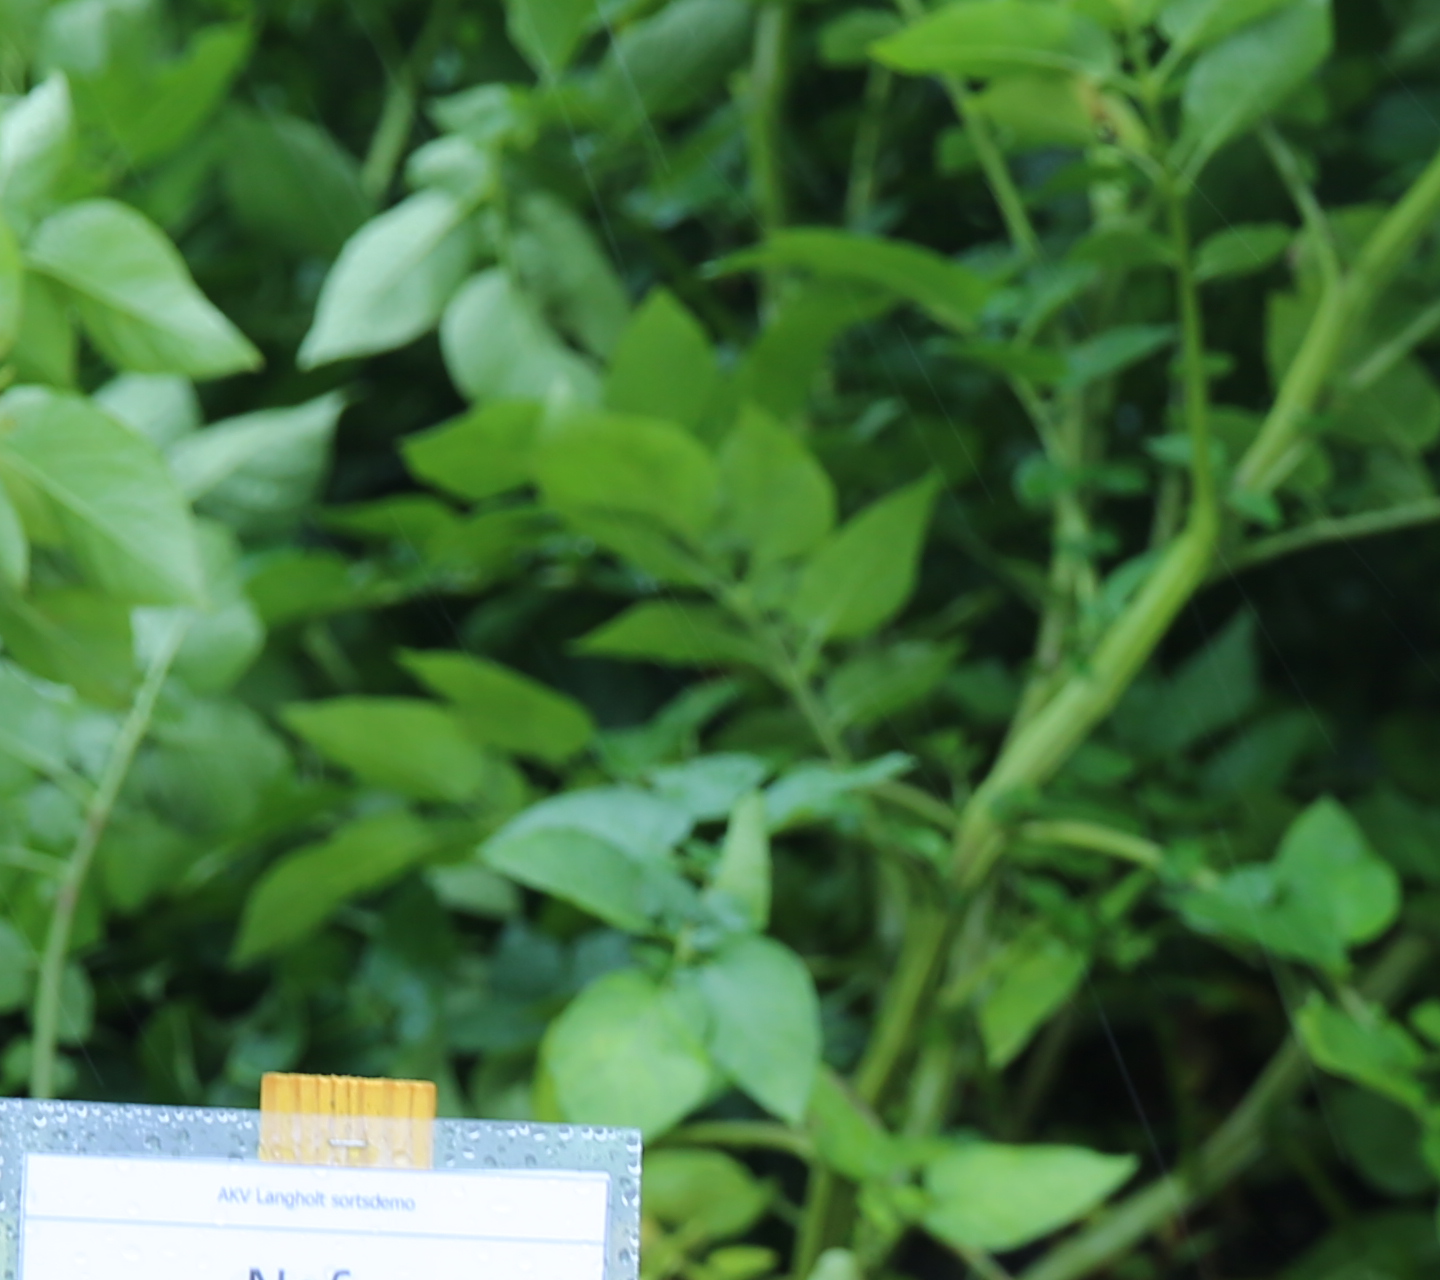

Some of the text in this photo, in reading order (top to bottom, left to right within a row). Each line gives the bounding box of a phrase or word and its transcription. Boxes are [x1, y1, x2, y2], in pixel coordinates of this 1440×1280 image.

[217, 1186, 416, 1211] AKV Langholt sortsdemo
